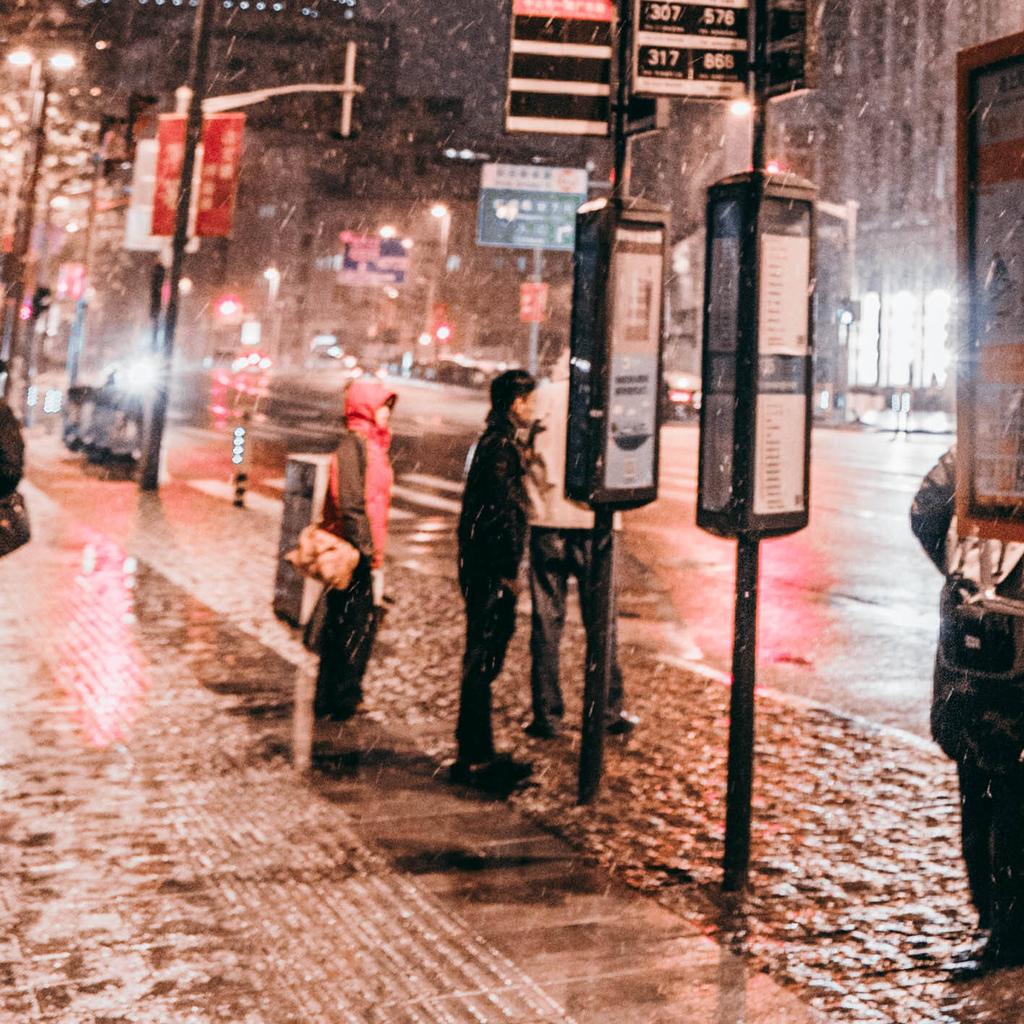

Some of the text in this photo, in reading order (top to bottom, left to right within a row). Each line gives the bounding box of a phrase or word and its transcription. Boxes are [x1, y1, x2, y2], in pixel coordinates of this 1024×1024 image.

[650, 3, 681, 22] 307
[703, 7, 735, 26] 576
[648, 48, 680, 67] 317
